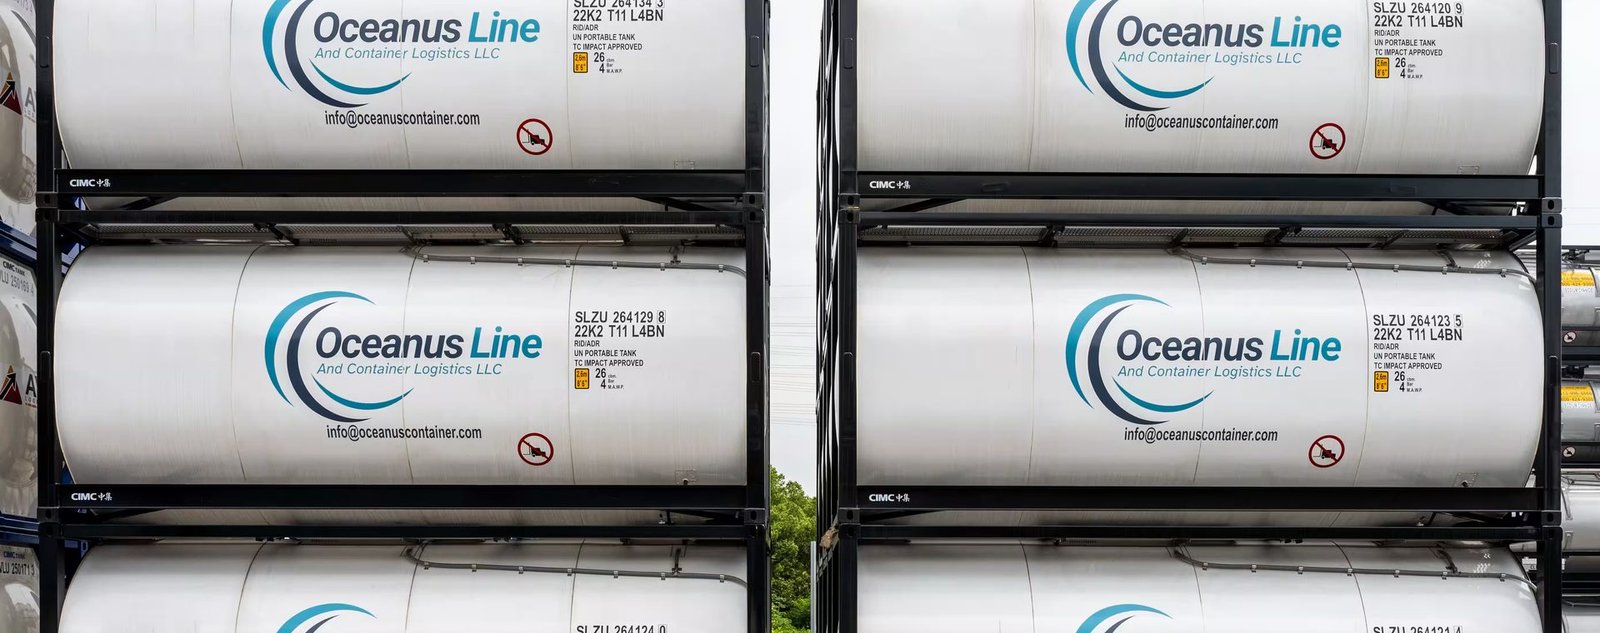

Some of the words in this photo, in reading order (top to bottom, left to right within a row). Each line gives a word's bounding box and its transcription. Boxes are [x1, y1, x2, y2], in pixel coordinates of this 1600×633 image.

[1374, 2, 1406, 13] SLZU
[1411, 2, 1451, 13] 264120
[1456, 2, 1462, 13] 9
[573, 10, 602, 21] 22K2
[608, 10, 626, 21] T11
[631, 10, 663, 21] L4BN
[1374, 15, 1402, 27] 22K2
[1408, 15, 1426, 27] T11
[1431, 15, 1463, 27] L4BN
[314, 12, 462, 43] Oceanus
[468, 11, 540, 43] Line
[1117, 16, 1264, 47] Oceanus
[1270, 16, 1342, 47] Line
[314, 47, 340, 59] And
[344, 47, 408, 59] Container
[412, 47, 470, 61] Logistics
[474, 48, 500, 59] LLC
[594, 52, 605, 62] 26
[1118, 51, 1144, 62] And
[1148, 51, 1211, 63] Container
[1215, 52, 1272, 66] Logistics
[1276, 52, 1302, 64] LLC
[599, 63, 605, 73] 4
[1395, 58, 1406, 68] 26
[1400, 69, 1406, 78] 4
[325, 110, 480, 128] info@oceanuscontainer.com
[1125, 114, 1279, 131] info@oceanuscontainer.com
[575, 311, 607, 323] SLZU
[613, 311, 654, 323] 264129
[658, 311, 664, 323] 8
[1373, 314, 1405, 326] SLZU
[1410, 314, 1450, 326] 264123
[1455, 314, 1462, 326] 5
[575, 325, 603, 337] 22K2
[609, 325, 627, 337] T11
[632, 325, 664, 337] L4BN
[1374, 328, 1402, 340] 22K2
[1407, 328, 1426, 340] T11
[1430, 328, 1462, 340] L4BN
[316, 326, 464, 358] Oceanus
[470, 326, 542, 358] Line
[1116, 329, 1264, 361] Oceanus
[1270, 329, 1342, 361] Line
[316, 363, 342, 374] And
[347, 363, 410, 374] Container
[414, 363, 472, 377] Logistics
[476, 364, 502, 375] LLC
[595, 368, 606, 378] 26
[1118, 365, 1143, 377] And
[1148, 365, 1210, 377] Container
[1214, 366, 1272, 380] Logistics
[1276, 366, 1302, 377] LLC
[1394, 371, 1405, 381] 26
[601, 379, 606, 389] 4
[1400, 382, 1405, 392] 4
[327, 425, 482, 441] info@oceanuscontainer.com
[1124, 427, 1278, 443] info@oceanuscontainer.com
